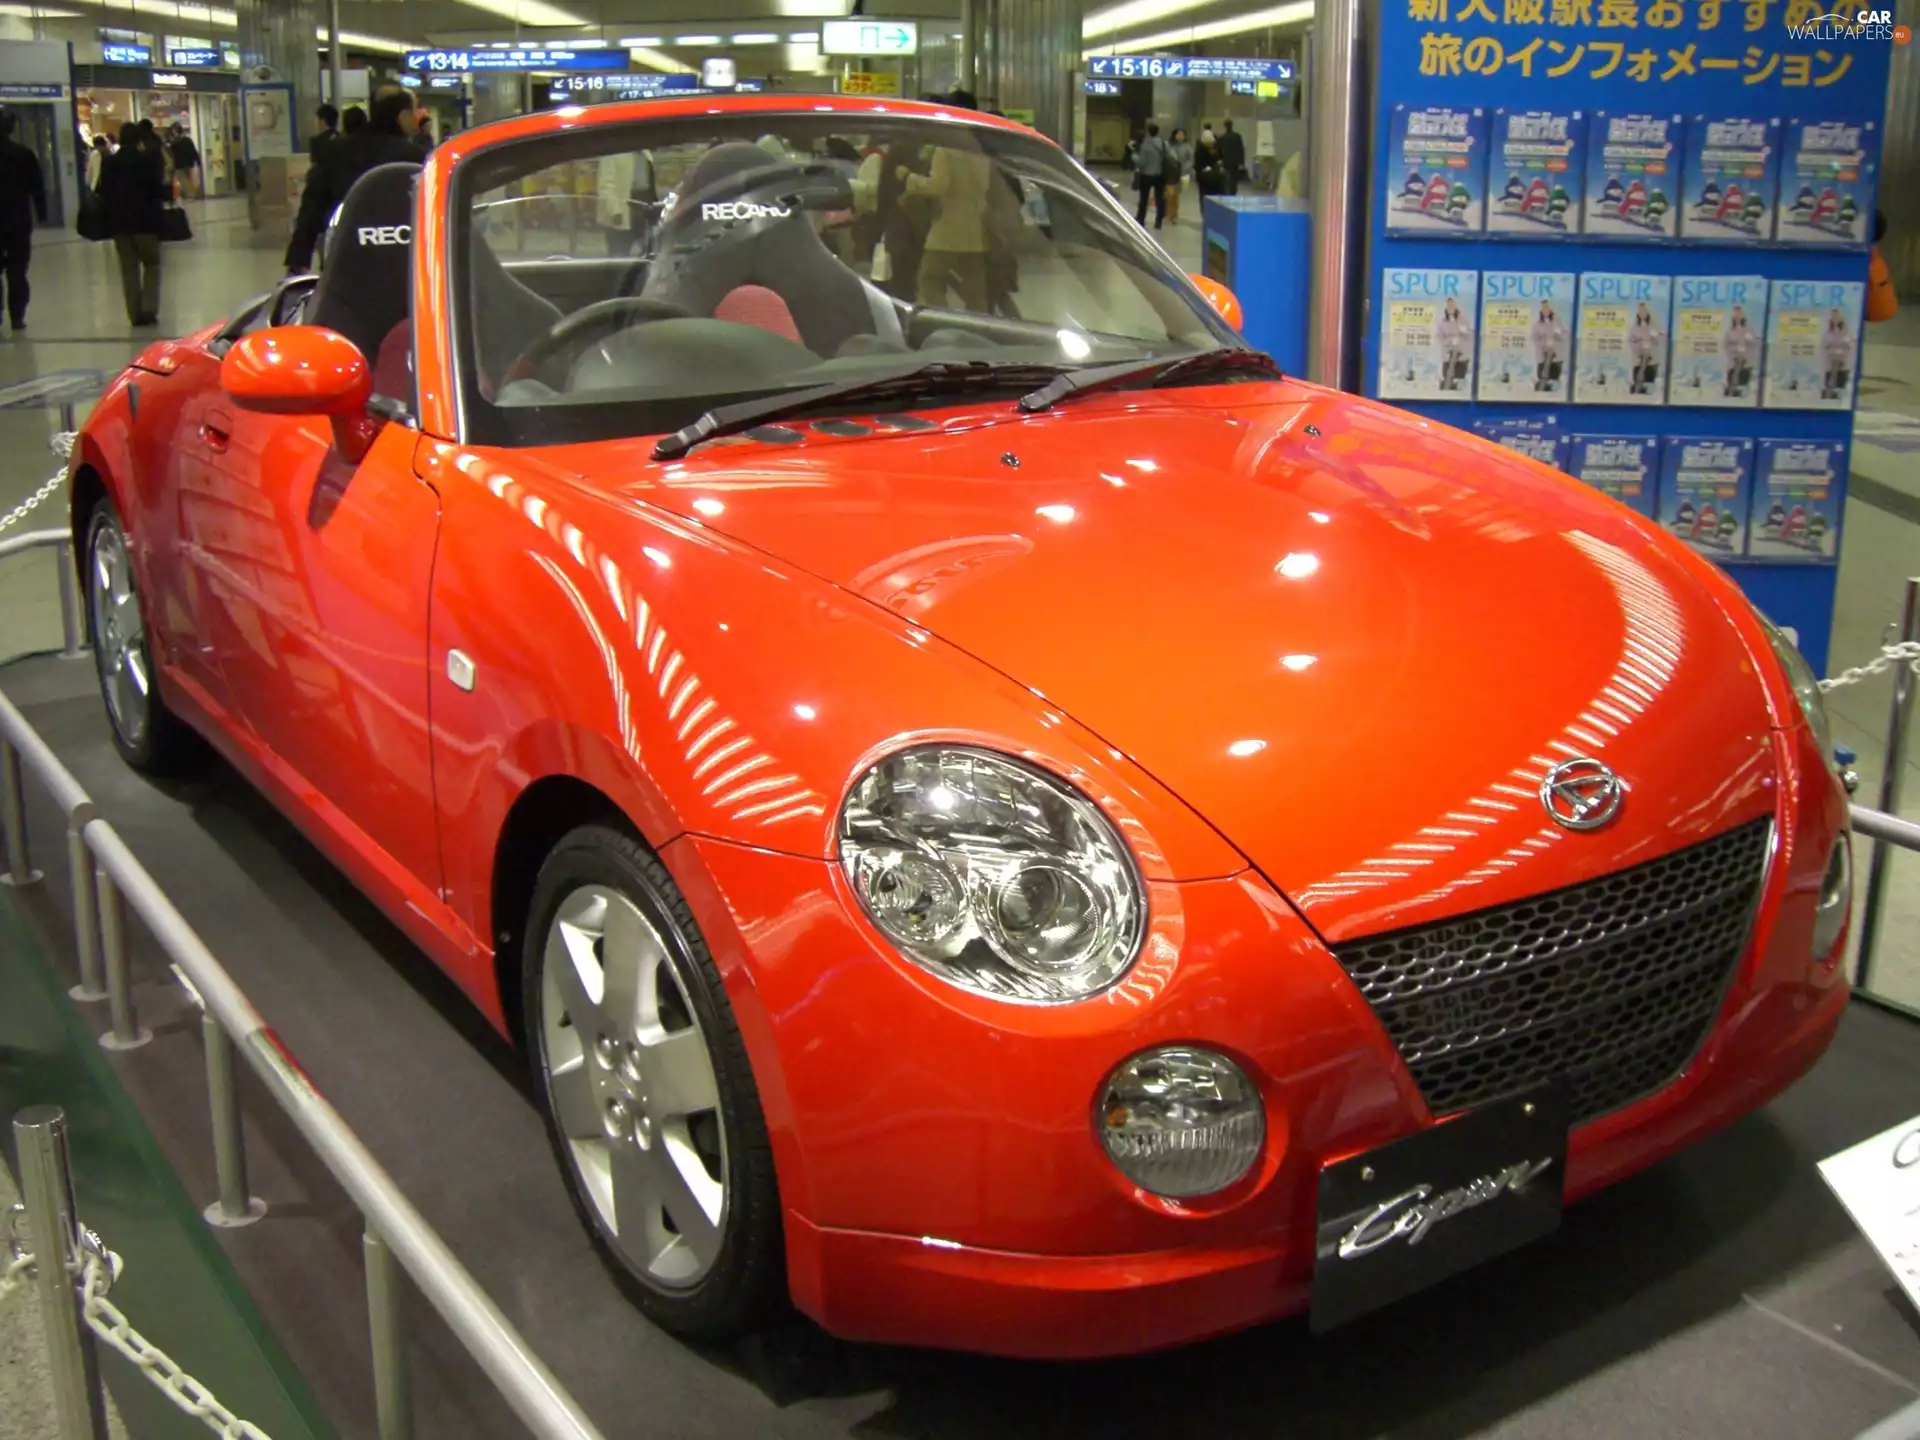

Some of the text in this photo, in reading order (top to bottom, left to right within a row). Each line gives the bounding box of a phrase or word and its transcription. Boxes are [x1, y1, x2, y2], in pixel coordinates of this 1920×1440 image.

[1418, 32, 1854, 87] 旅のインフォメーション
[1391, 272, 1460, 297] SPUR
[1487, 275, 1554, 298] SPUR
[1585, 277, 1652, 301] SPUR
[1681, 280, 1748, 304] SPUR
[1781, 283, 1846, 307] SPUR
